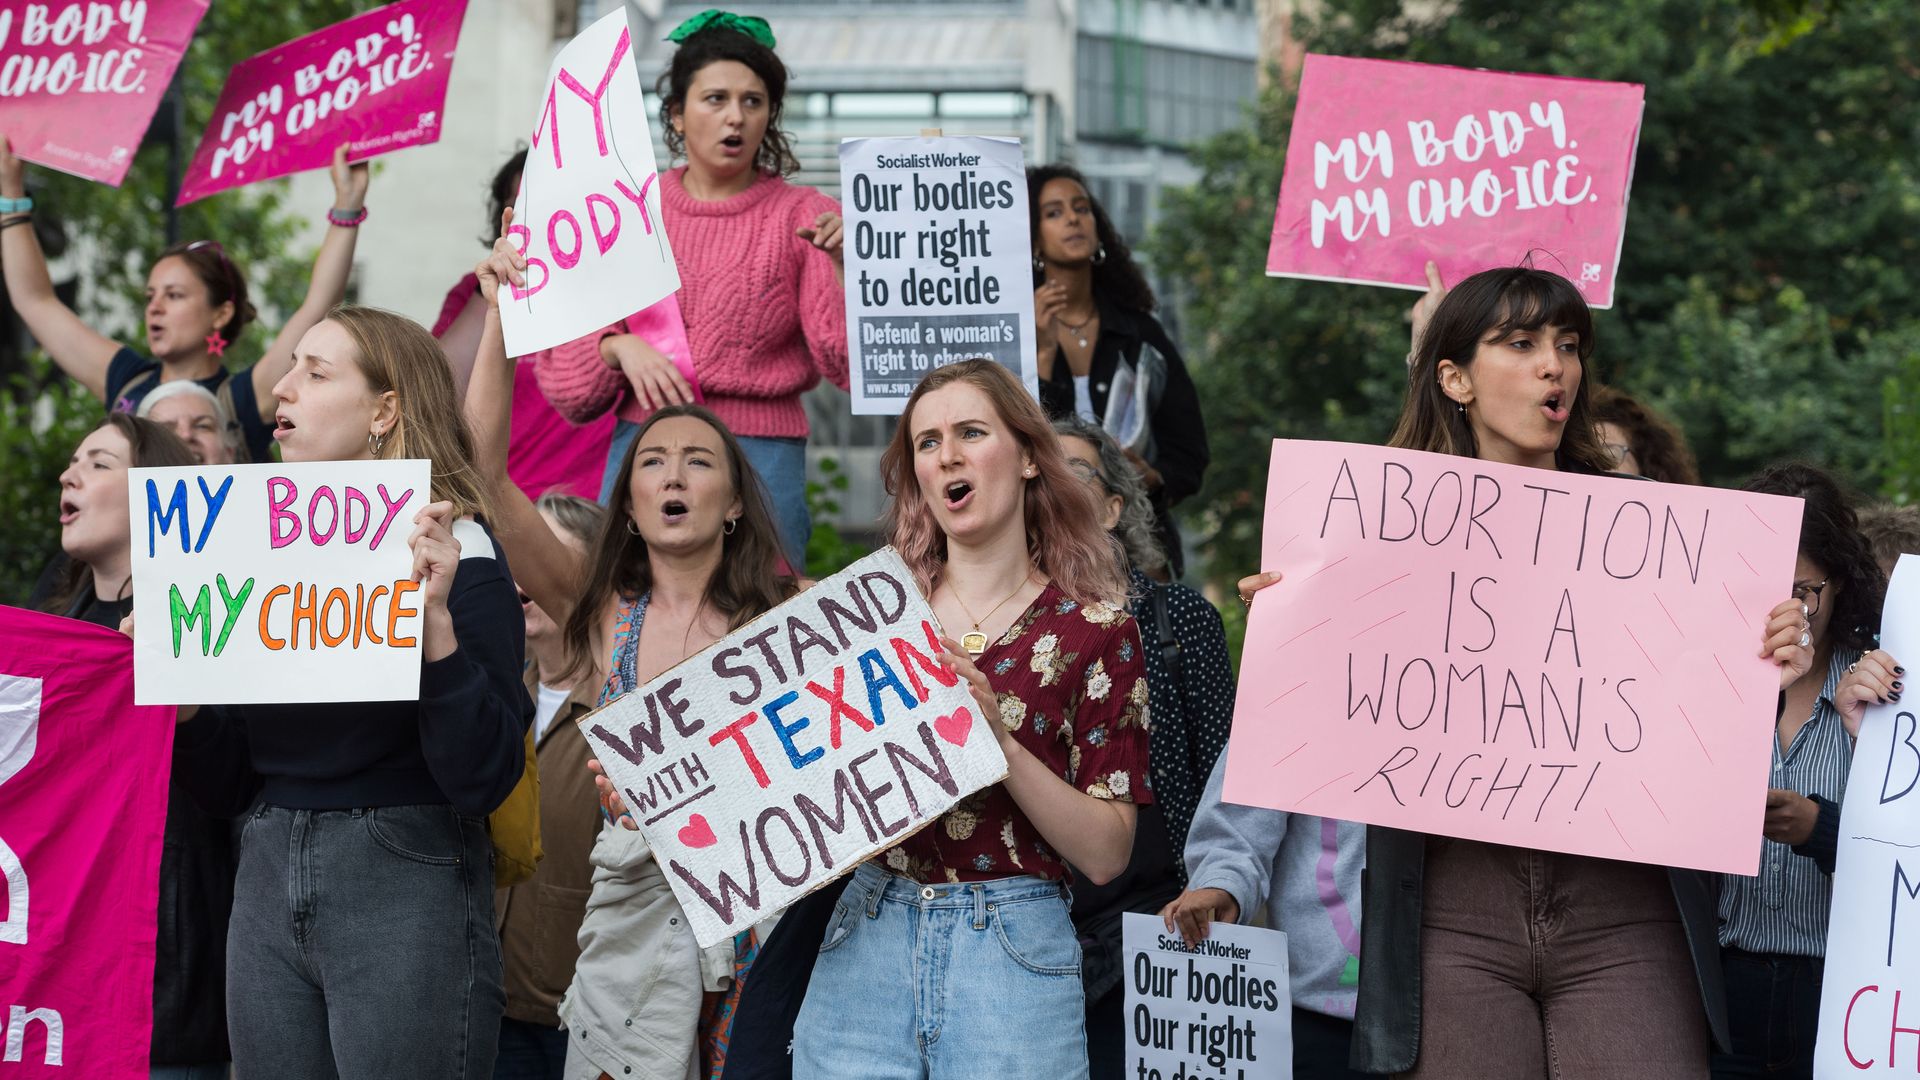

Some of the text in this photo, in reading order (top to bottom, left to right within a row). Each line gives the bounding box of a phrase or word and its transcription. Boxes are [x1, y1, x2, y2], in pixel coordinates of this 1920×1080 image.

[21, 0, 147, 46] BODY.
[0, 48, 146, 97] CHOICE.
[210, 42, 434, 179] MY CHOICE.
[220, 13, 422, 142] MY BODY.
[1314, 100, 1578, 190] MY BODY.
[853, 171, 1014, 212] Our bodies
[1311, 155, 1598, 249] MY CHOICE.
[507, 172, 657, 301] BODY
[855, 219, 992, 268] Our right
[859, 266, 1000, 307] to decide
[863, 319, 1014, 345] Defend a woman's
[865, 349, 906, 376] right
[910, 349, 929, 370] to
[146, 475, 414, 558] MY BODY
[1320, 458, 1709, 584] ABORTION
[169, 573, 421, 658] MY CHOICE
[1444, 571, 1581, 667] IS A
[589, 571, 906, 766] WE STAND
[1347, 652, 1642, 753] WOMAN'S
[625, 620, 959, 813] WITH TEXAN
[670, 721, 959, 925] WOMEN
[1354, 746, 1601, 824] RIGHT!
[1134, 952, 1178, 999] Our
[1187, 959, 1278, 1011] bodies
[1134, 1003, 1257, 1068] Our right
